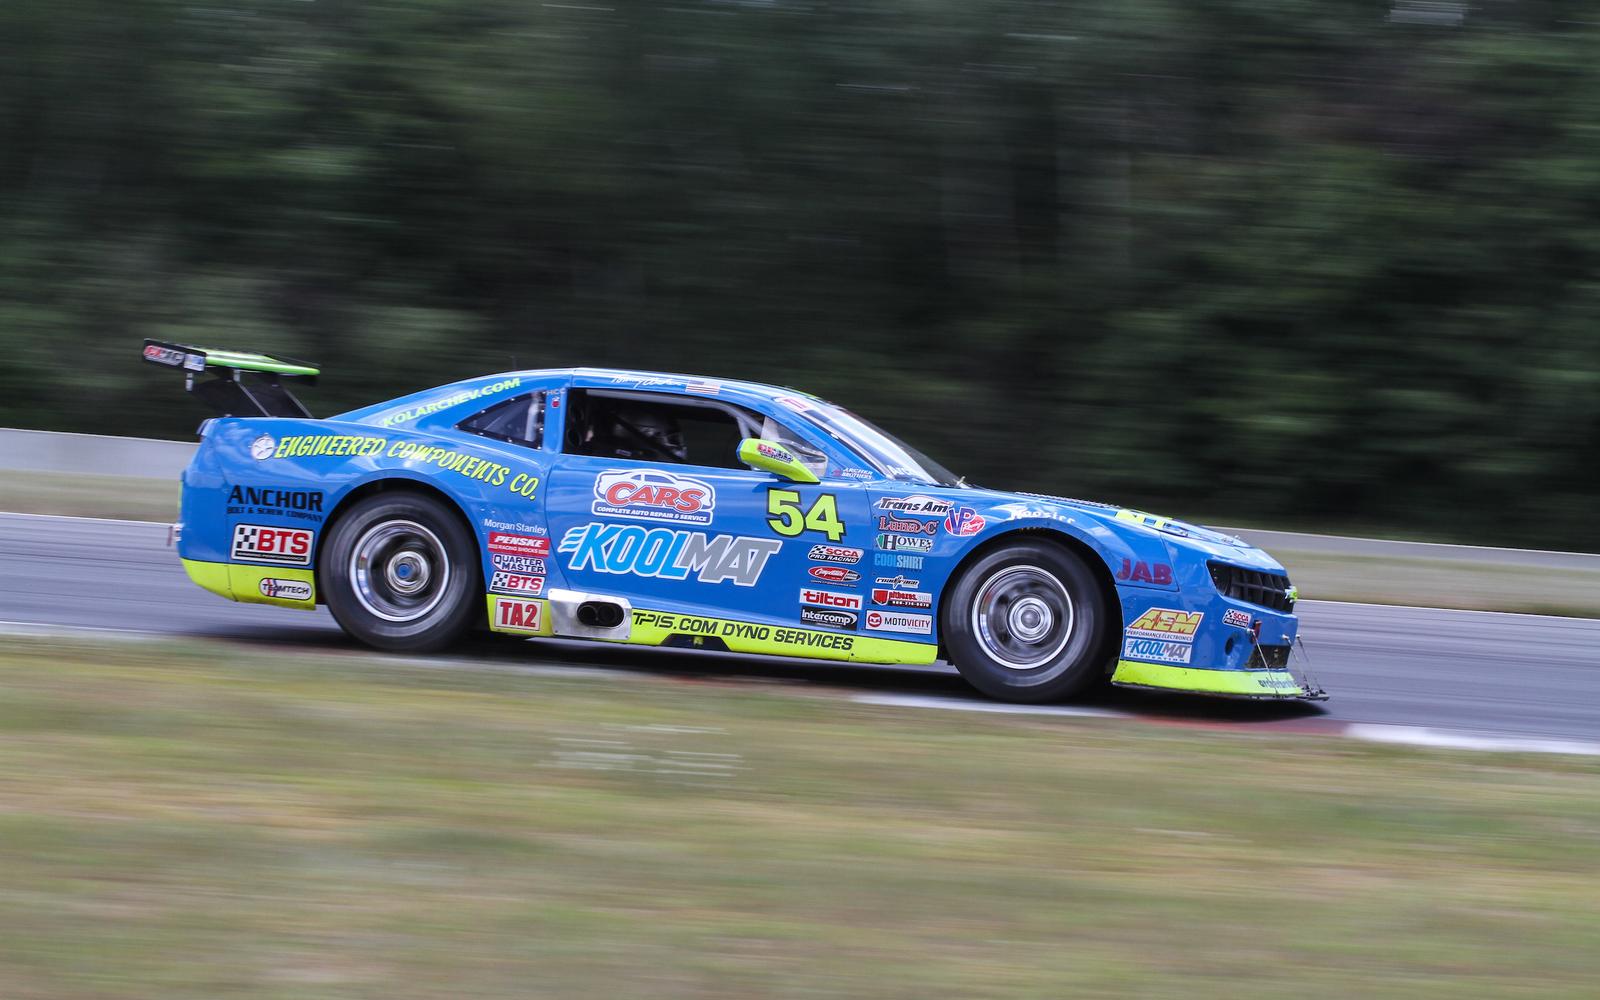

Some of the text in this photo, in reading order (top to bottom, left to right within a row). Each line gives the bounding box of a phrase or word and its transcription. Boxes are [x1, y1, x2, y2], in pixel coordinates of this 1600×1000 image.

[274, 435, 539, 500] ENGINEERED COMPONENTS CO.
[227, 485, 323, 512] ANCHOR
[605, 481, 705, 514] CARS
[880, 498, 949, 513] Trans Am
[766, 488, 847, 543] 54
[949, 508, 976, 534] VP
[484, 519, 547, 535] Morgan Stanley
[257, 529, 309, 554] BTS
[494, 535, 544, 548] PENSKE
[883, 534, 927, 550] HOWE
[494, 555, 542, 566] QUARTER
[567, 523, 783, 587] KOOLMAT
[826, 548, 859, 557] SCCA
[501, 563, 543, 573] MASTER
[874, 553, 924, 569] COOLSHIRT
[1116, 558, 1172, 585] JAB
[262, 584, 309, 594] TEAMTECH
[507, 575, 542, 590] BTS
[803, 591, 858, 608] tilton
[500, 602, 538, 627] TA2
[802, 609, 851, 625] Intercomp
[884, 617, 930, 628] MOTOVICITY
[1130, 608, 1201, 635] AEM
[1233, 613, 1249, 621] SCCA
[632, 612, 854, 650] TPIS.COM DYNO SERVICES
[1130, 640, 1190, 658] KOOLMAT
